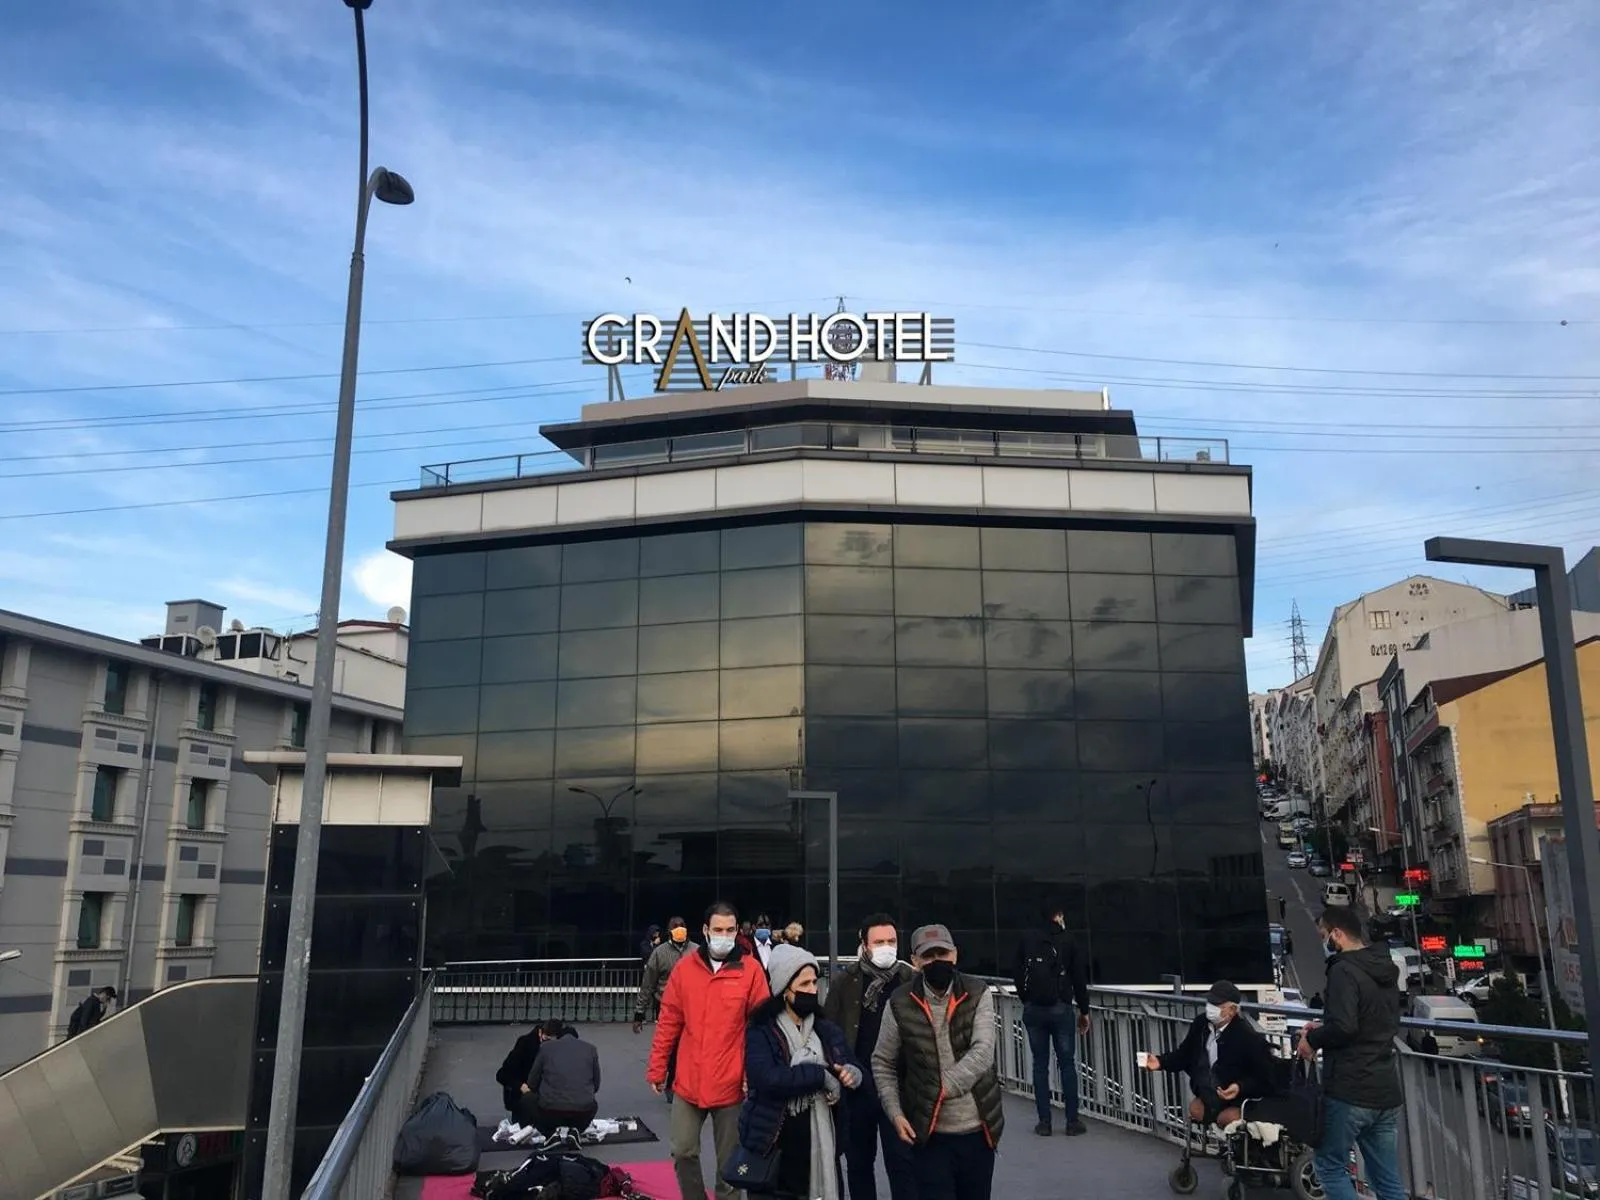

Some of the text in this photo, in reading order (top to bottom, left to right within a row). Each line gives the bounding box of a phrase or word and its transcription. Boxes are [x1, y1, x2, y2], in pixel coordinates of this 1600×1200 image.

[586, 306, 949, 392] GRAND HOTEL
[716, 361, 768, 392] park
